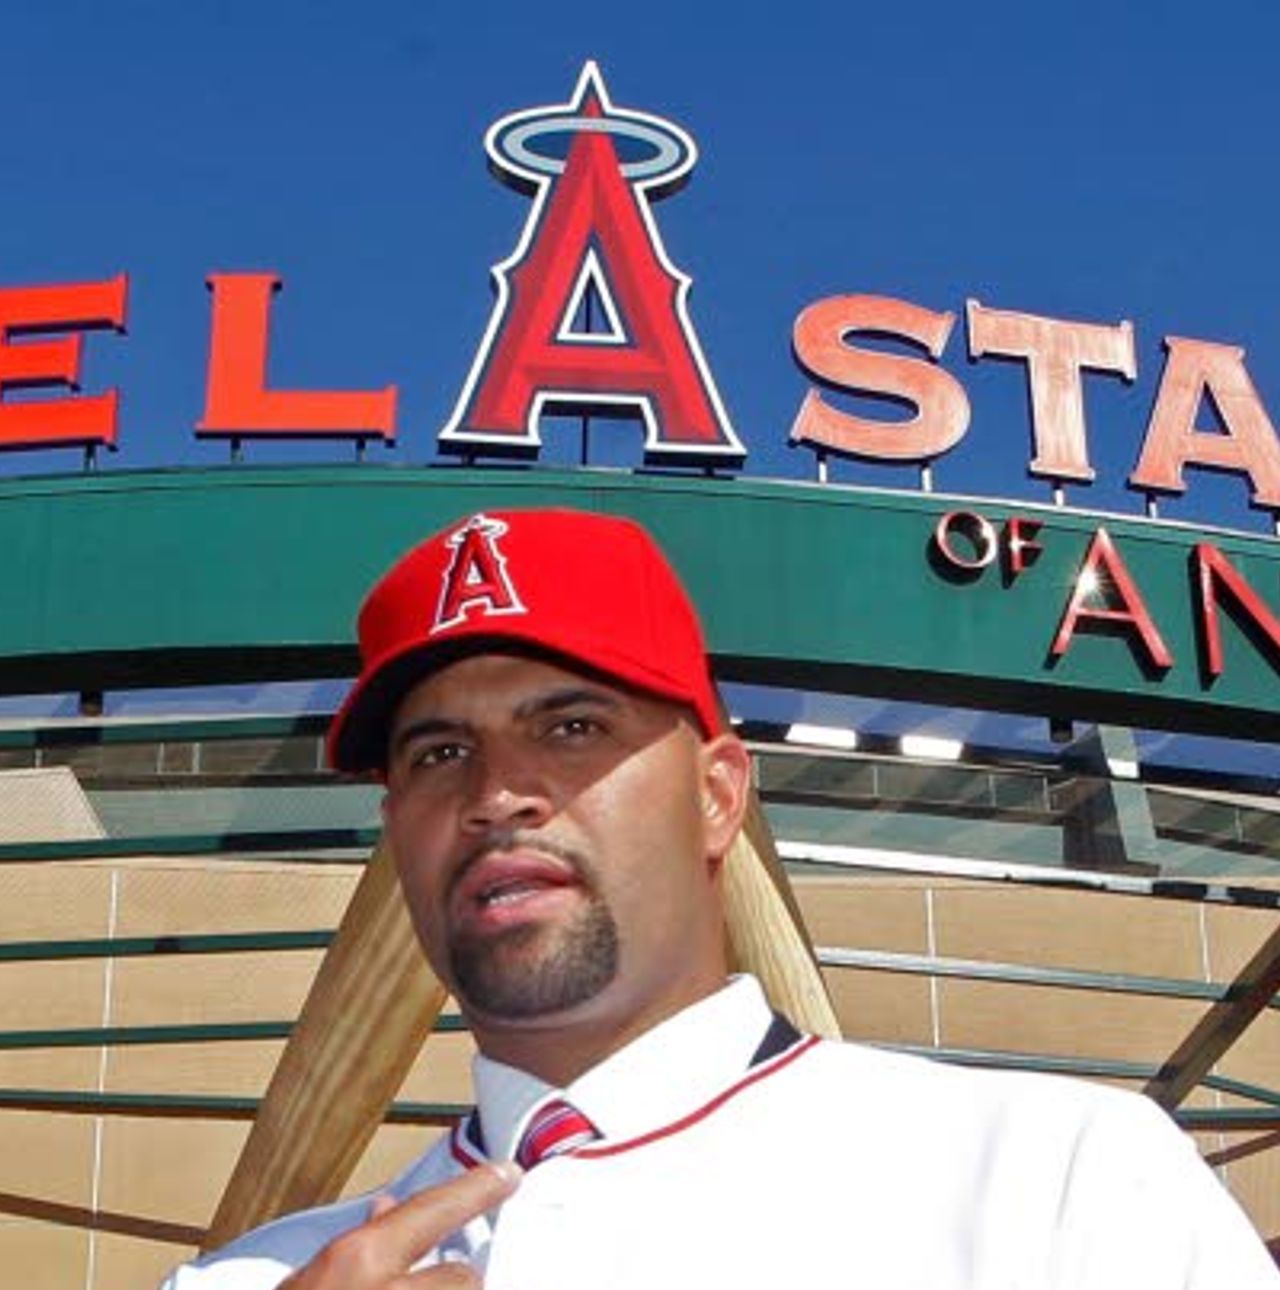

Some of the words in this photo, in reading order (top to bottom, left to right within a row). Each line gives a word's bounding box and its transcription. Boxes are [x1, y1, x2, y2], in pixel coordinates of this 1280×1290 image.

[436, 58, 748, 468] A
[428, 512, 529, 636] A
[935, 510, 1041, 585] OF
